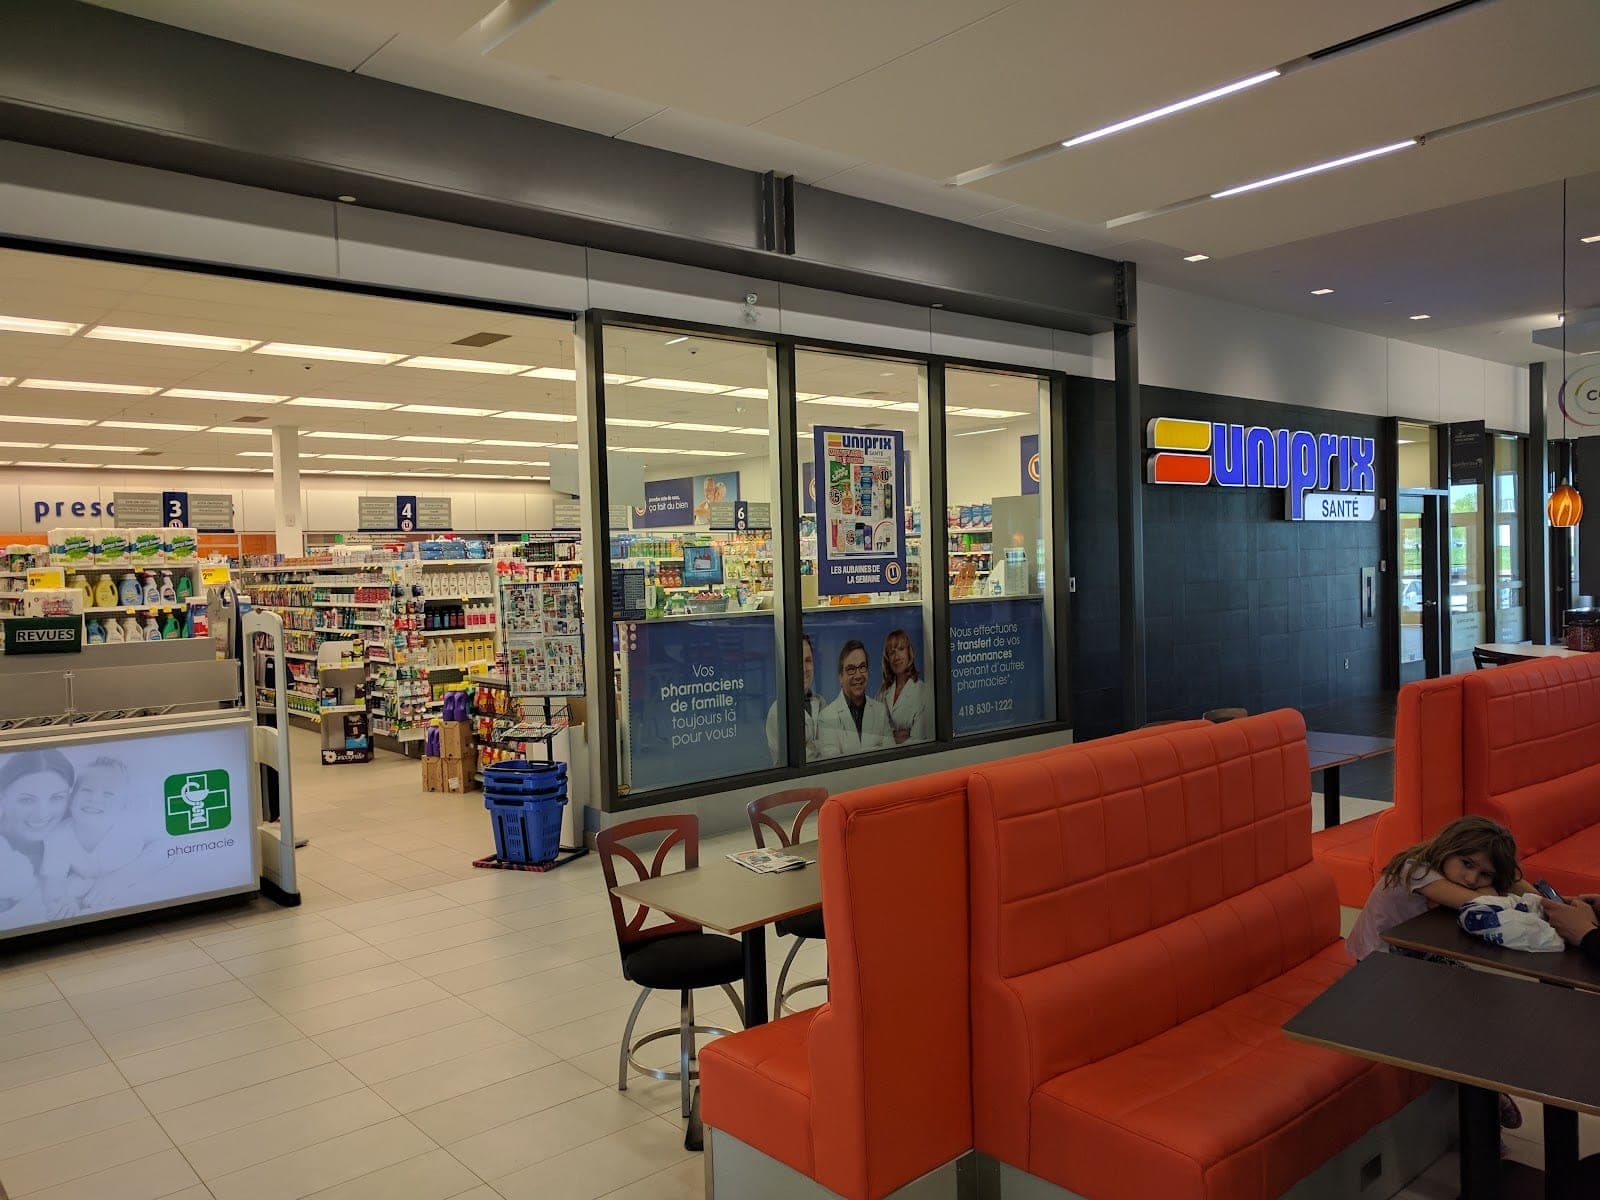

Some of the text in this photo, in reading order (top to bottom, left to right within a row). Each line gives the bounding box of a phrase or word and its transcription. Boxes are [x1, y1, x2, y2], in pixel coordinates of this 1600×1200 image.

[842, 435, 892, 456] uniprix
[1212, 422, 1376, 521] uniprix
[169, 500, 182, 518] 3
[401, 503, 413, 519] 4
[737, 507, 745, 520] 6
[1321, 497, 1359, 518] SANTÉ
[17, 629, 74, 641] REVUES
[949, 623, 1018, 639] Nous effectuons
[957, 636, 991, 651] transfert
[993, 636, 1005, 647] de
[1006, 637, 1021, 646] vos
[956, 648, 1013, 665] ordonnances
[692, 664, 715, 678] Vos
[661, 678, 745, 701] pharmaciens
[670, 699, 688, 713] de
[958, 698, 1013, 717] 418 830-1222
[672, 712, 722, 730] toujours
[672, 724, 737, 749] pour vous!
[167, 838, 235, 859] pharmacie
